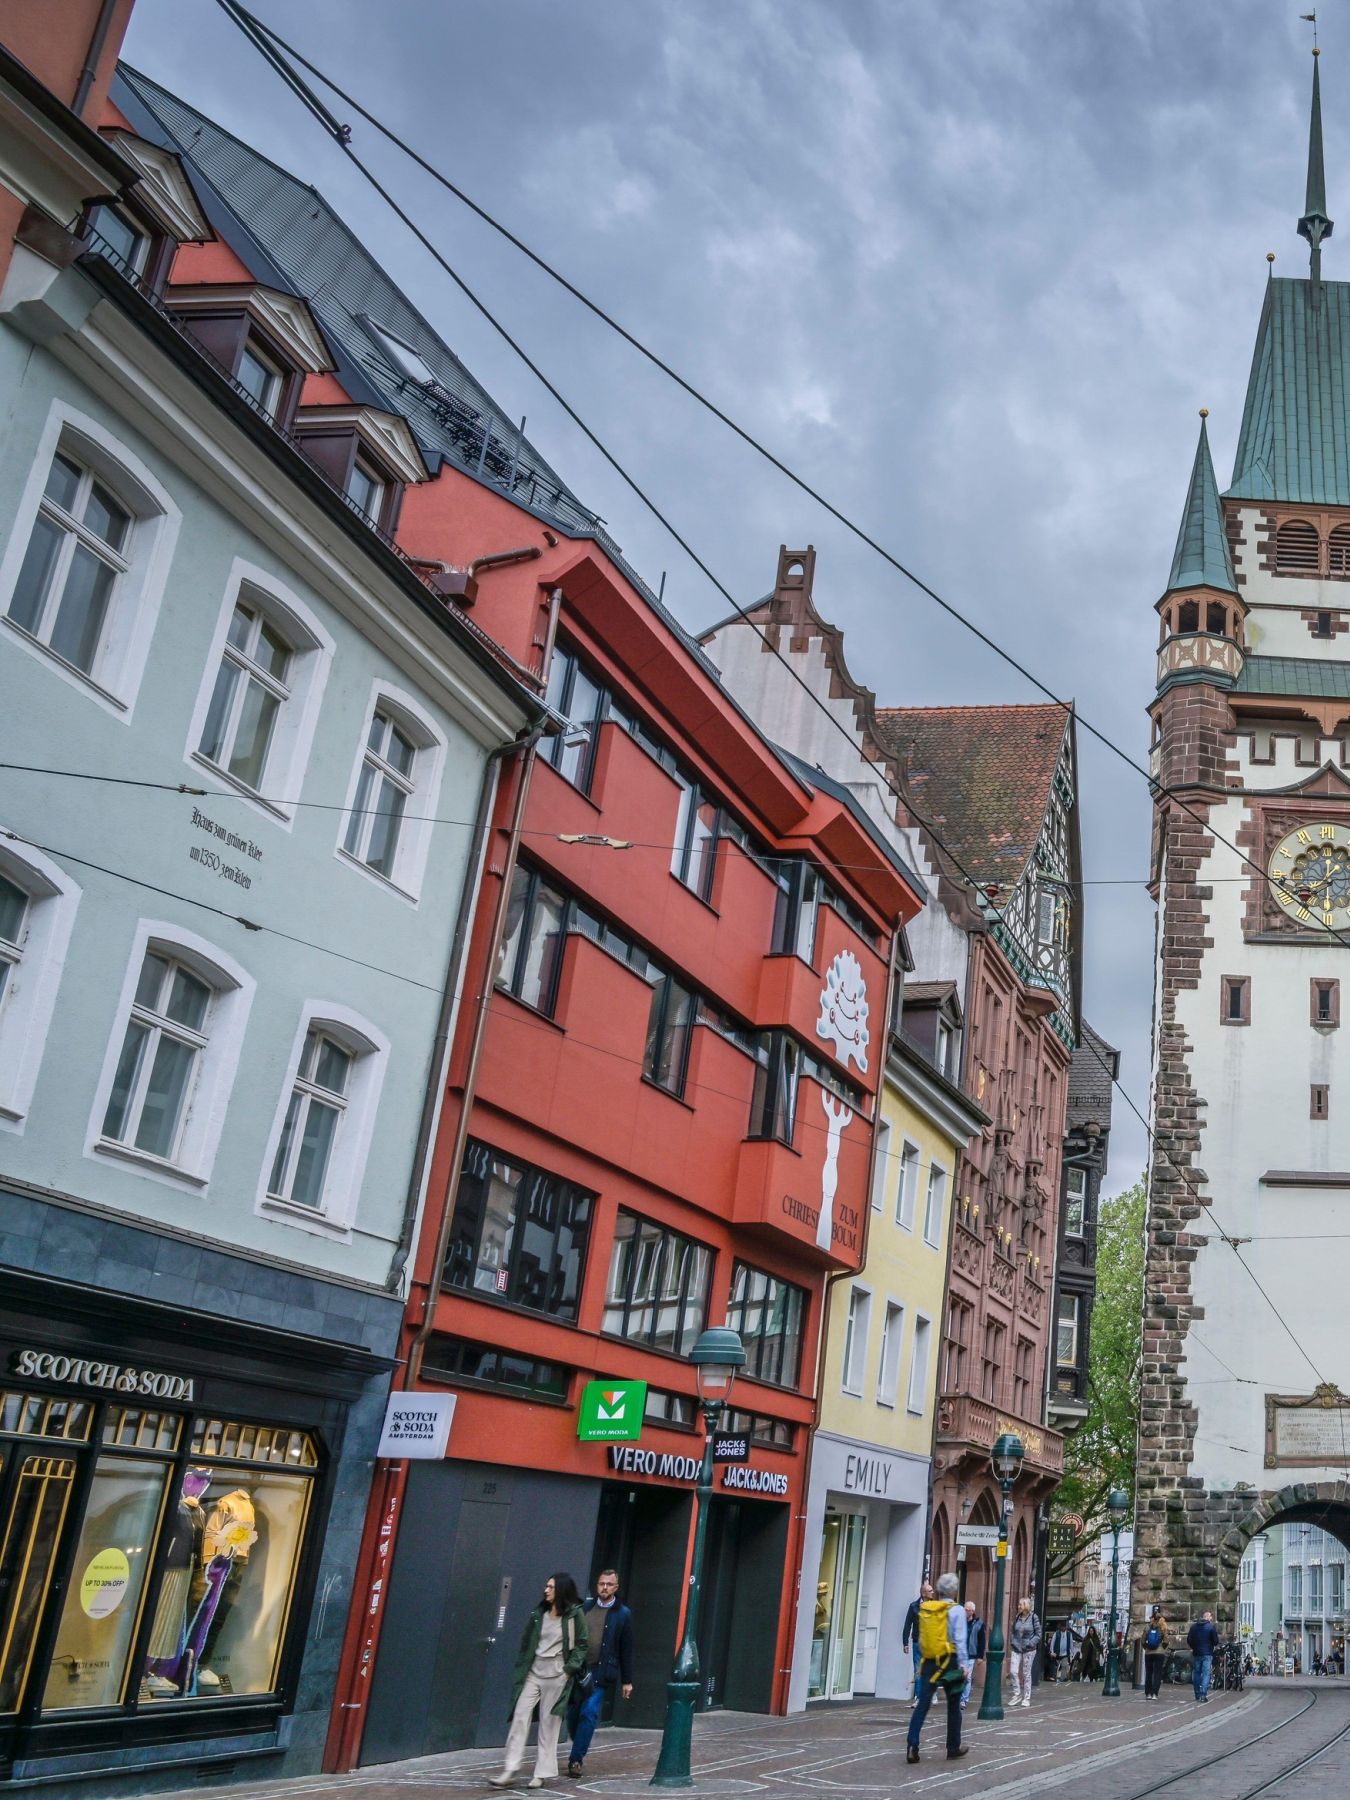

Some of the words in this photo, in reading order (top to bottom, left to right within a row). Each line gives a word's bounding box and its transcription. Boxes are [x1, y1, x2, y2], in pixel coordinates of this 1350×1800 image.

[200, 848, 220, 871] 1350
[840, 1204, 859, 1229] ZUM
[831, 1221, 857, 1251] BOUM
[389, 1422, 401, 1432] &
[403, 1422, 434, 1432] SODA
[392, 1411, 438, 1422] SCOTCH
[715, 1440, 746, 1448] JACK&
[715, 1447, 746, 1456] JONES
[612, 1446, 657, 1474] VERO
[844, 1455, 892, 1495] EMILY
